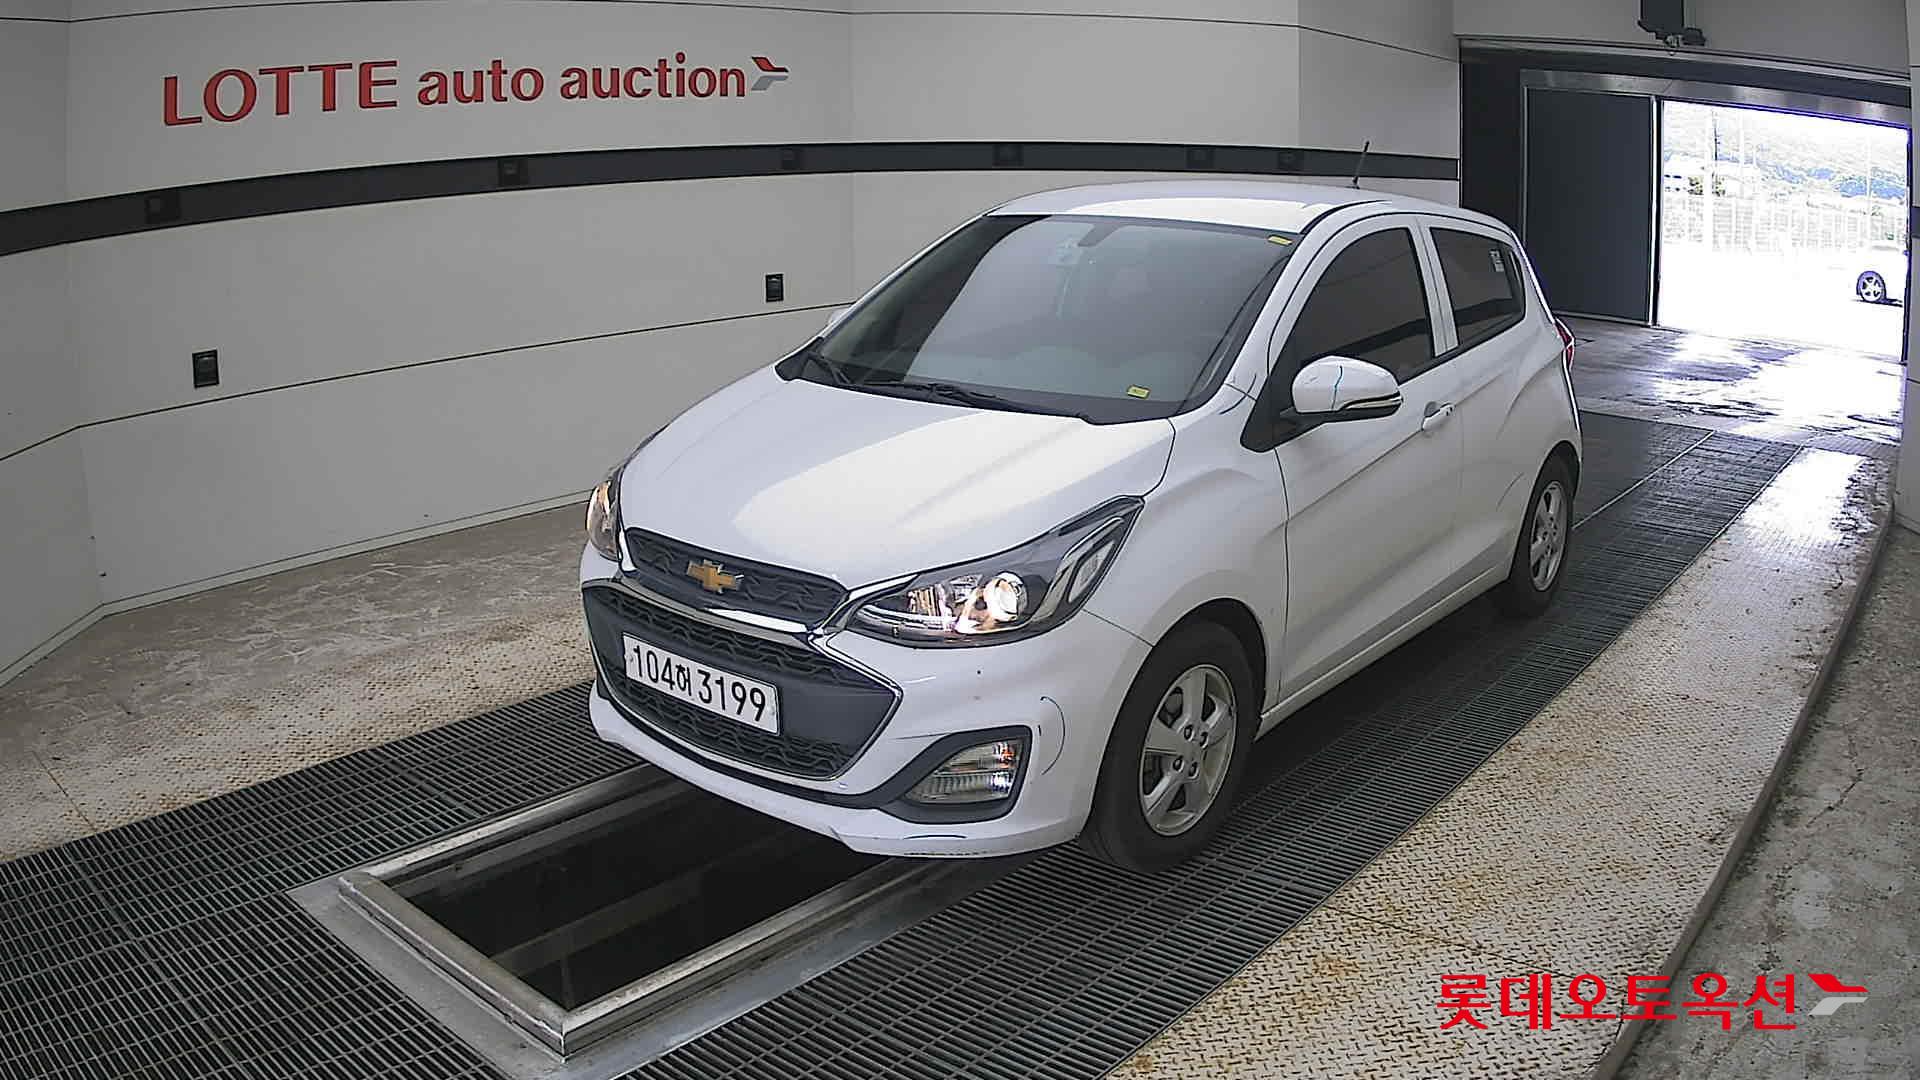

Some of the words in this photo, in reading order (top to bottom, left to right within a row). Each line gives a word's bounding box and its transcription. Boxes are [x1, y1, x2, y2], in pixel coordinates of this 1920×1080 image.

[163, 61, 399, 126] LOTTE
[417, 60, 544, 105] auto
[560, 53, 746, 99] auction
